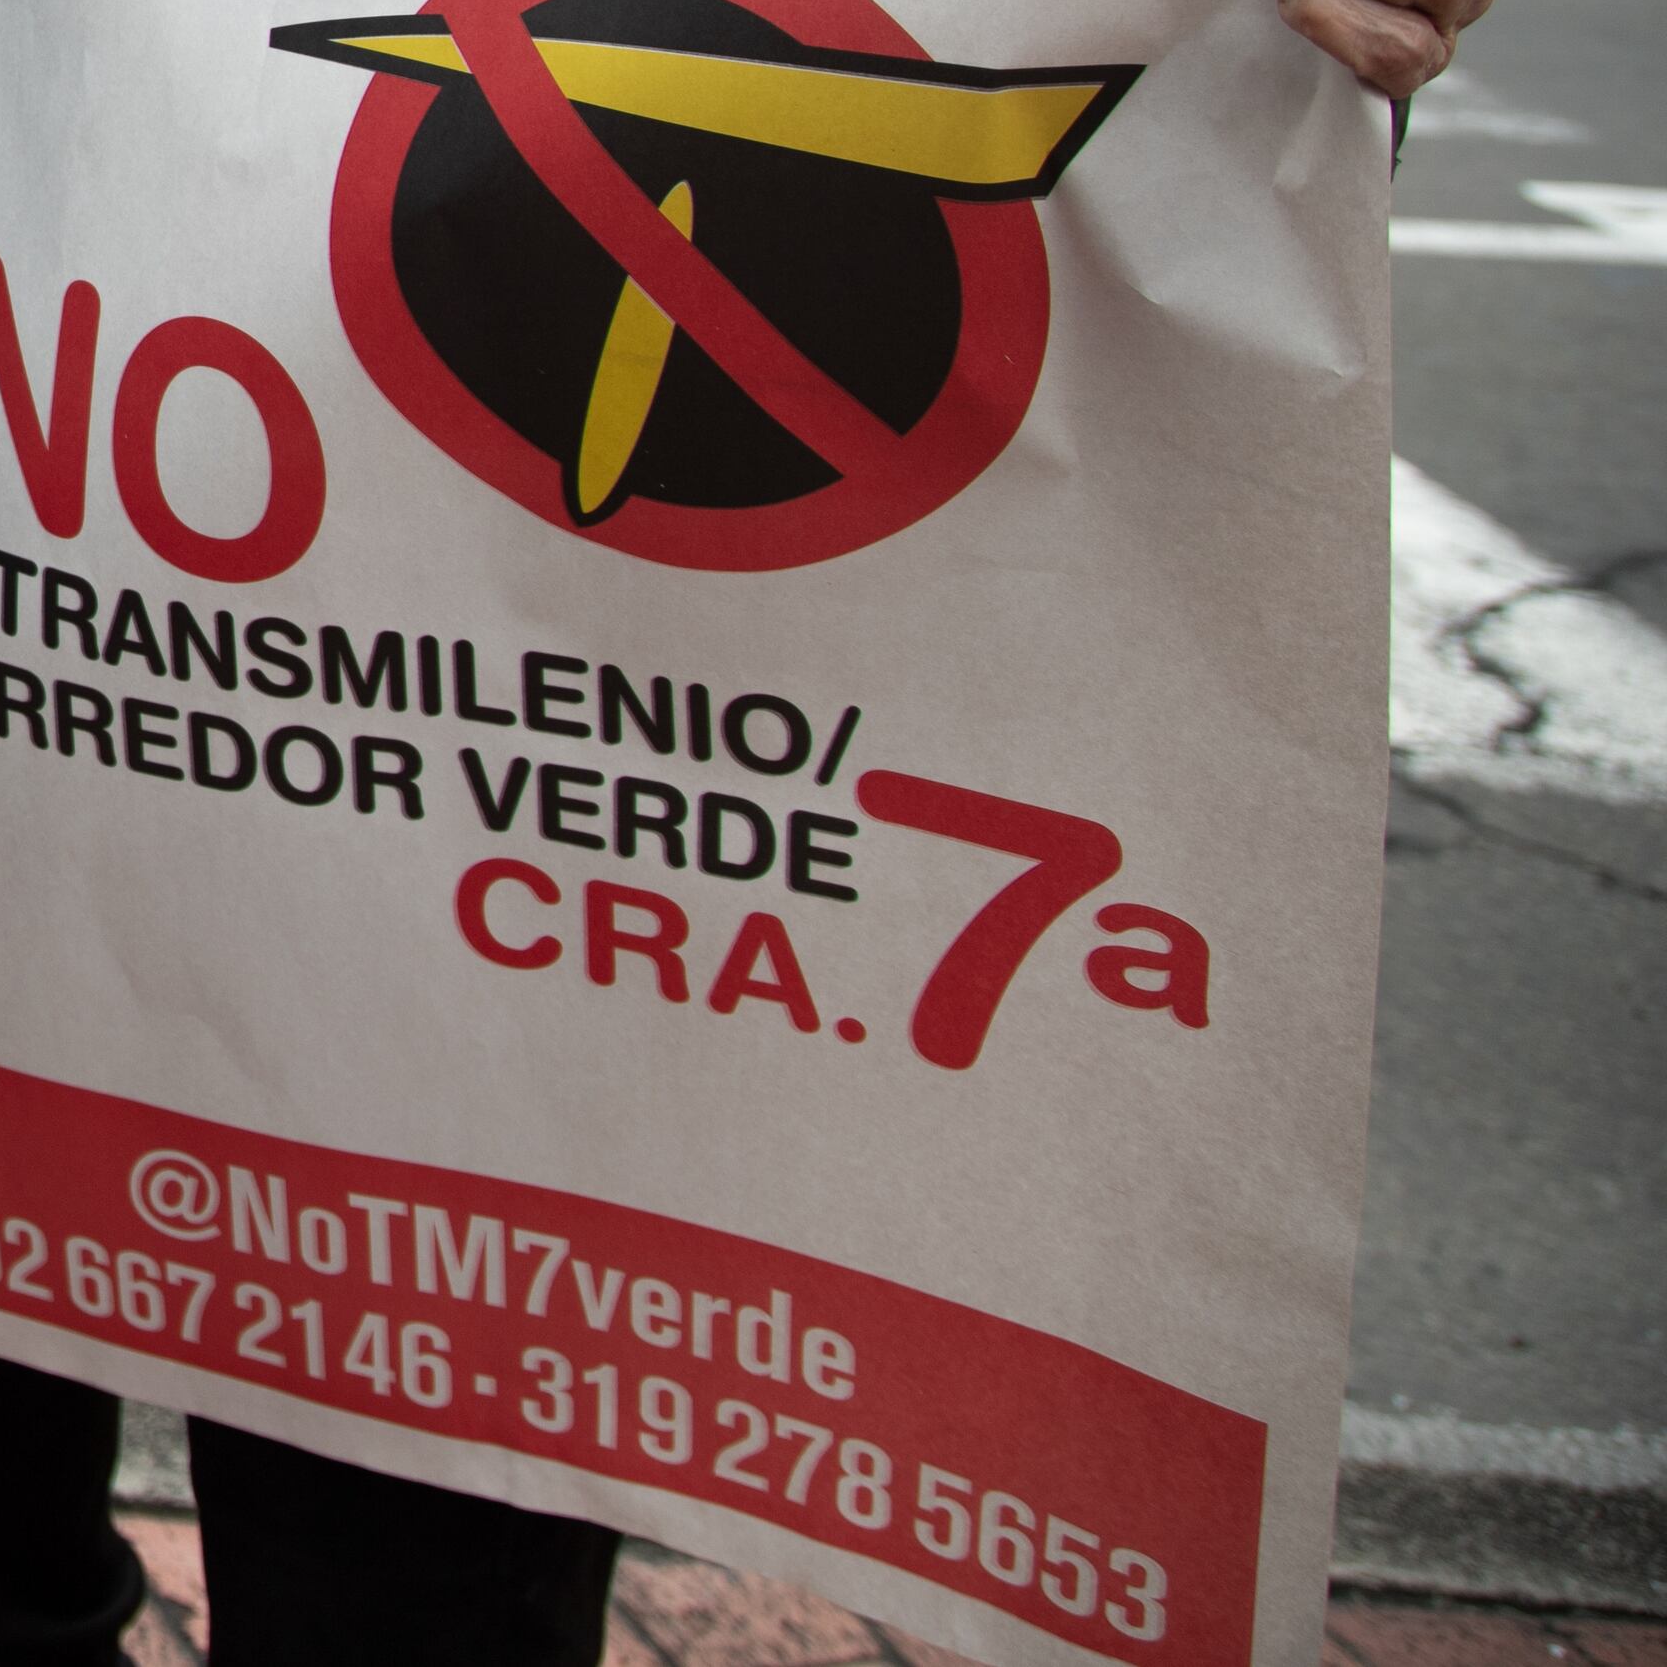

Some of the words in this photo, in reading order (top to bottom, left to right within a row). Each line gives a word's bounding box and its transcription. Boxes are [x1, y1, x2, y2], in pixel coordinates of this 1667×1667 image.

[459, 748, 858, 902] VERDE
[455, 858, 865, 1043] CRA.
[128, 1148, 856, 1400] @NoTM7verde
[66, 1237, 215, 1342] 667
[235, 1283, 452, 1408] 2146
[522, 1348, 692, 1464] 319
[714, 1400, 891, 1529] 278
[915, 1464, 1166, 1641] 5653
